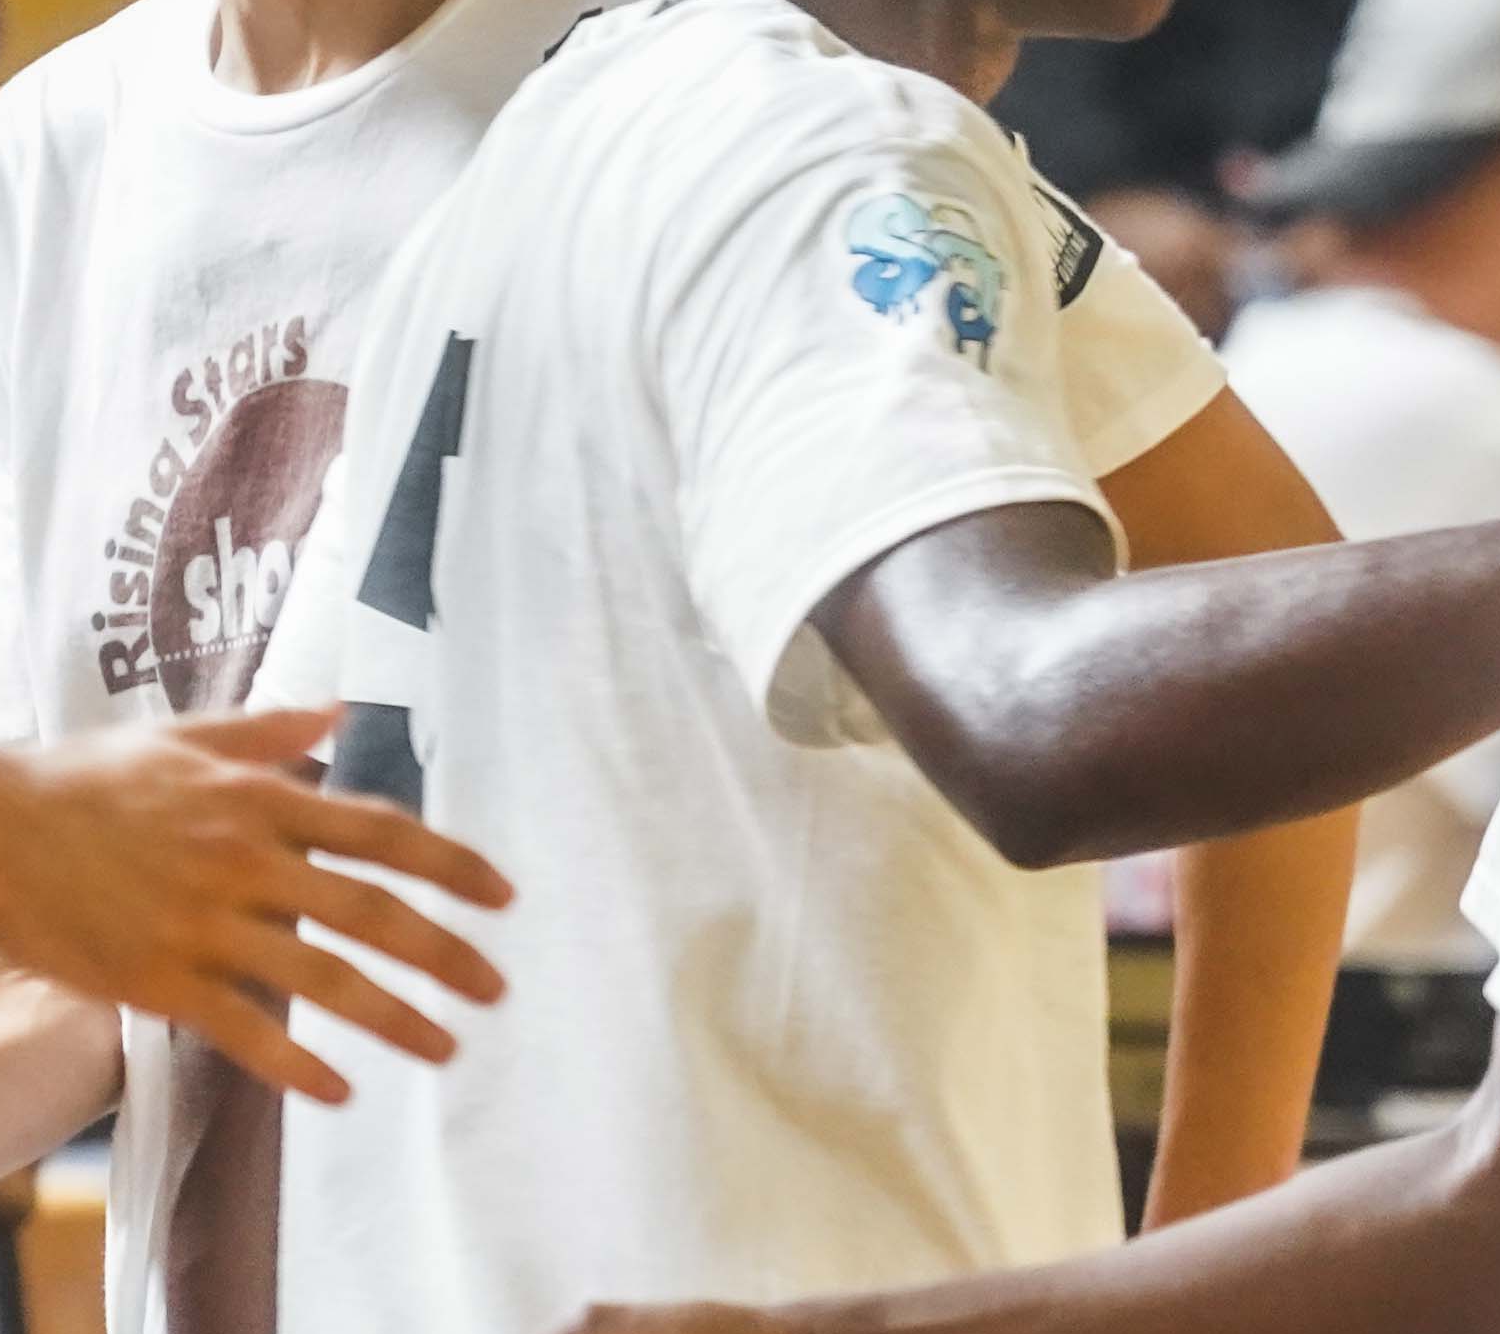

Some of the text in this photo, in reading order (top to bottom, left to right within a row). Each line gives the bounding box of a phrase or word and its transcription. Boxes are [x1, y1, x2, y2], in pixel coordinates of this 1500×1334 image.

[91, 315, 309, 695] Rising Stars
[183, 515, 294, 644] sho
